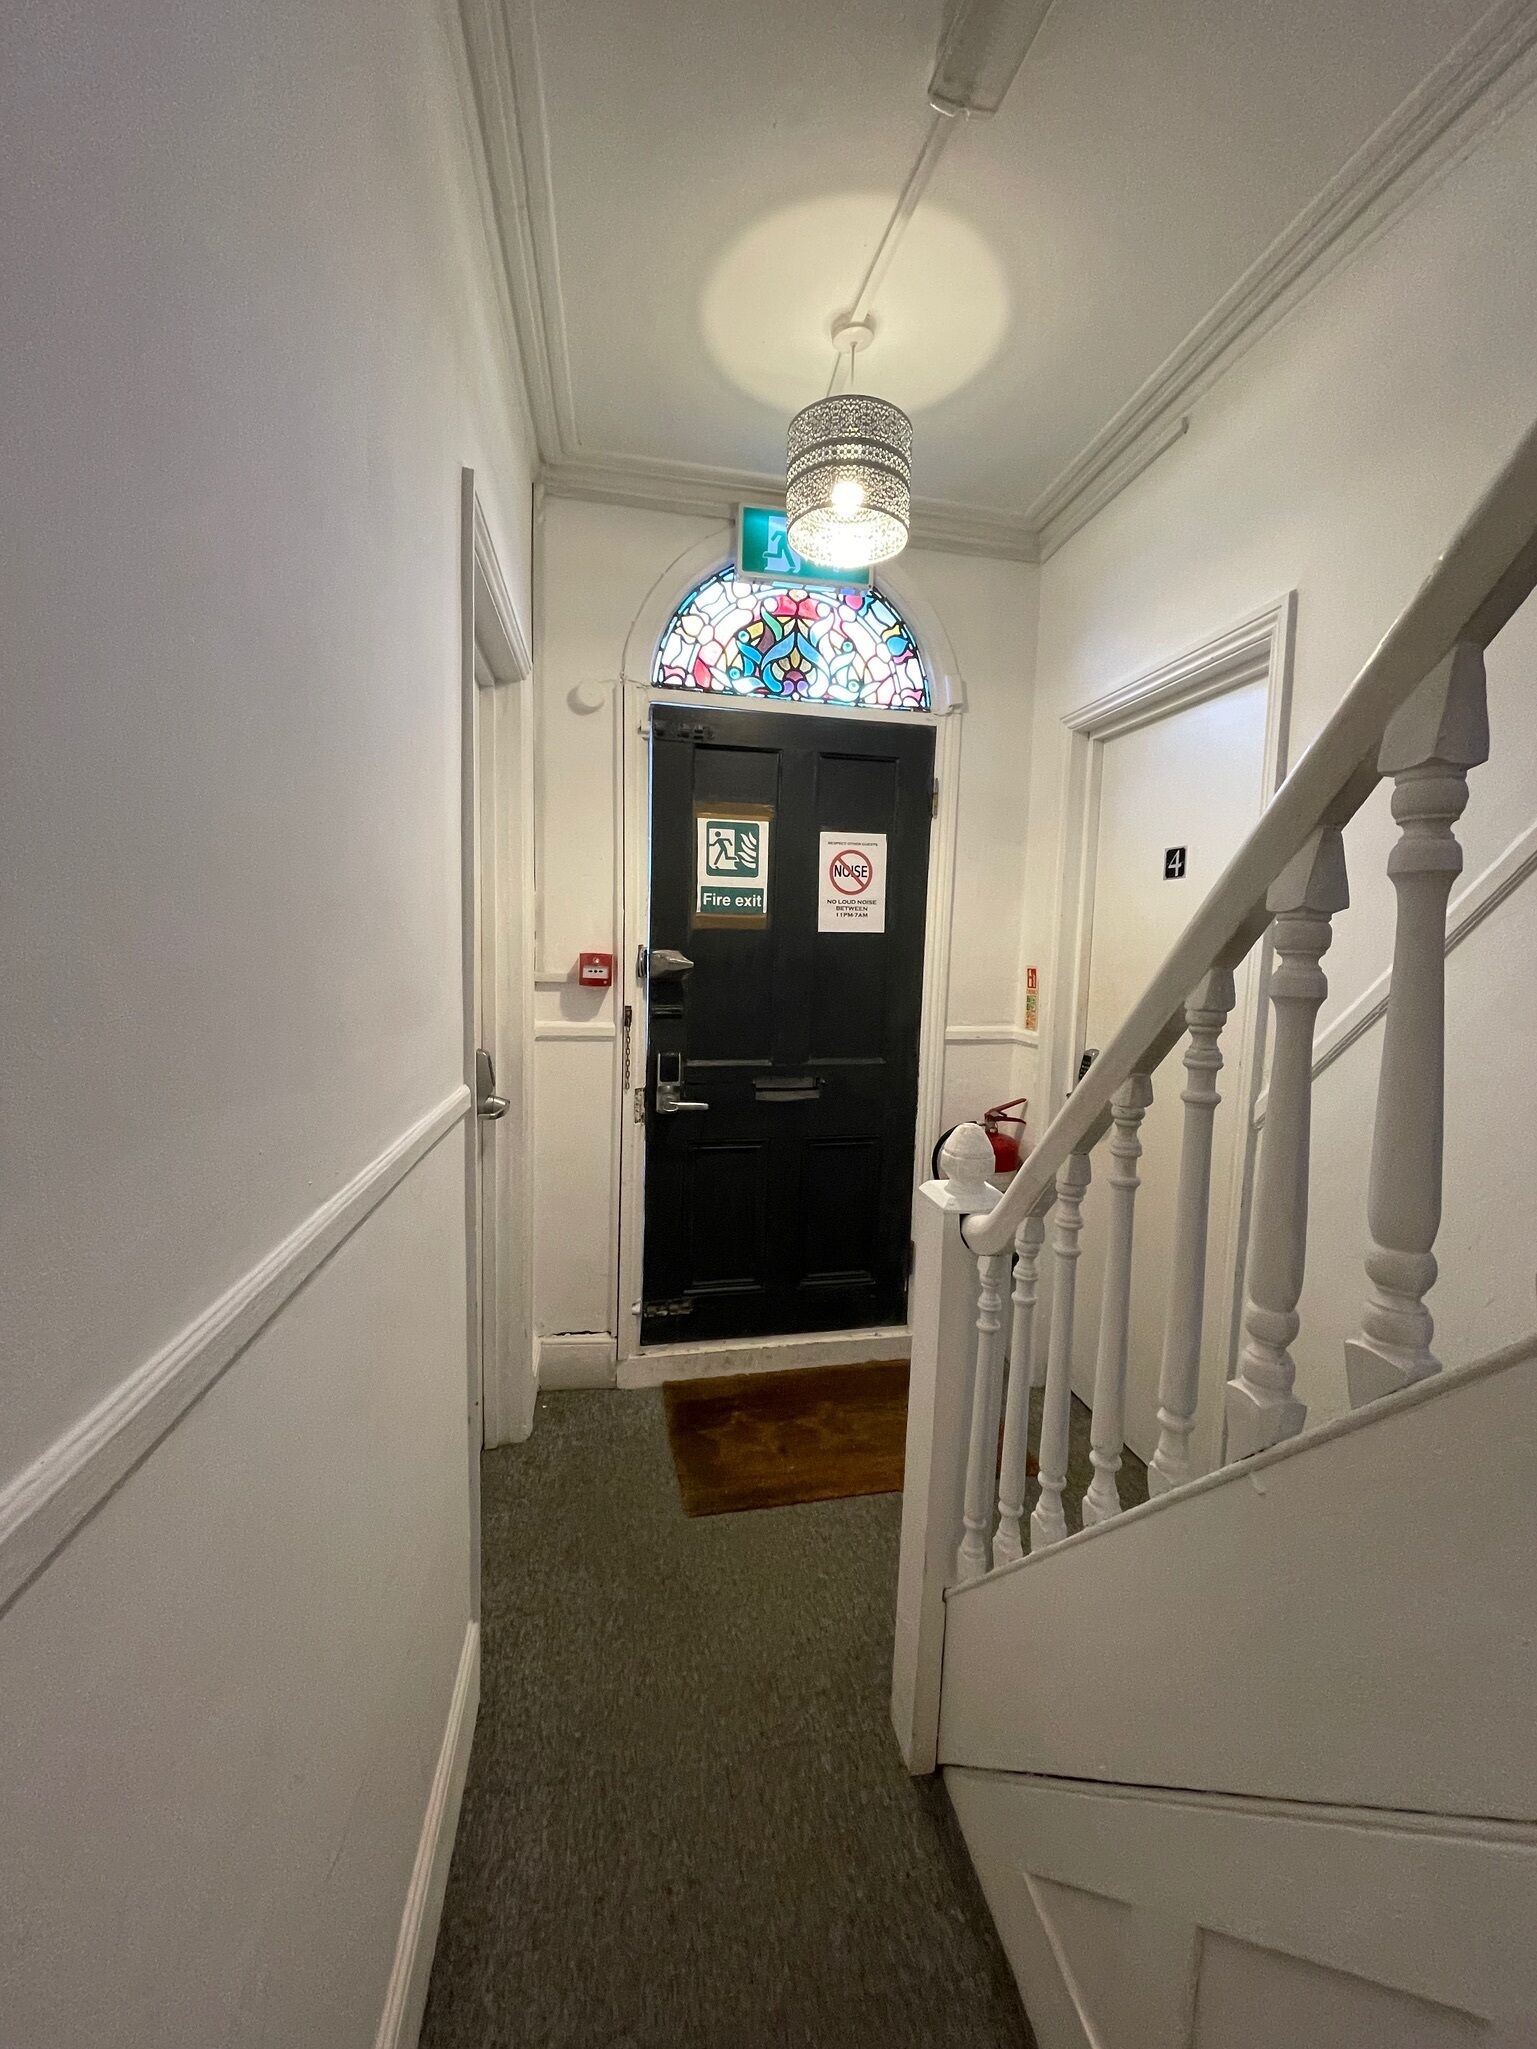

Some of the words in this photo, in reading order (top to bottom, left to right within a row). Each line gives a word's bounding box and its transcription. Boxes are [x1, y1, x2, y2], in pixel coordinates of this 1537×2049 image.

[1168, 850, 1182, 877] 4
[834, 865, 868, 878] NOISE
[703, 892, 731, 906] Fire
[735, 894, 762, 907] exit
